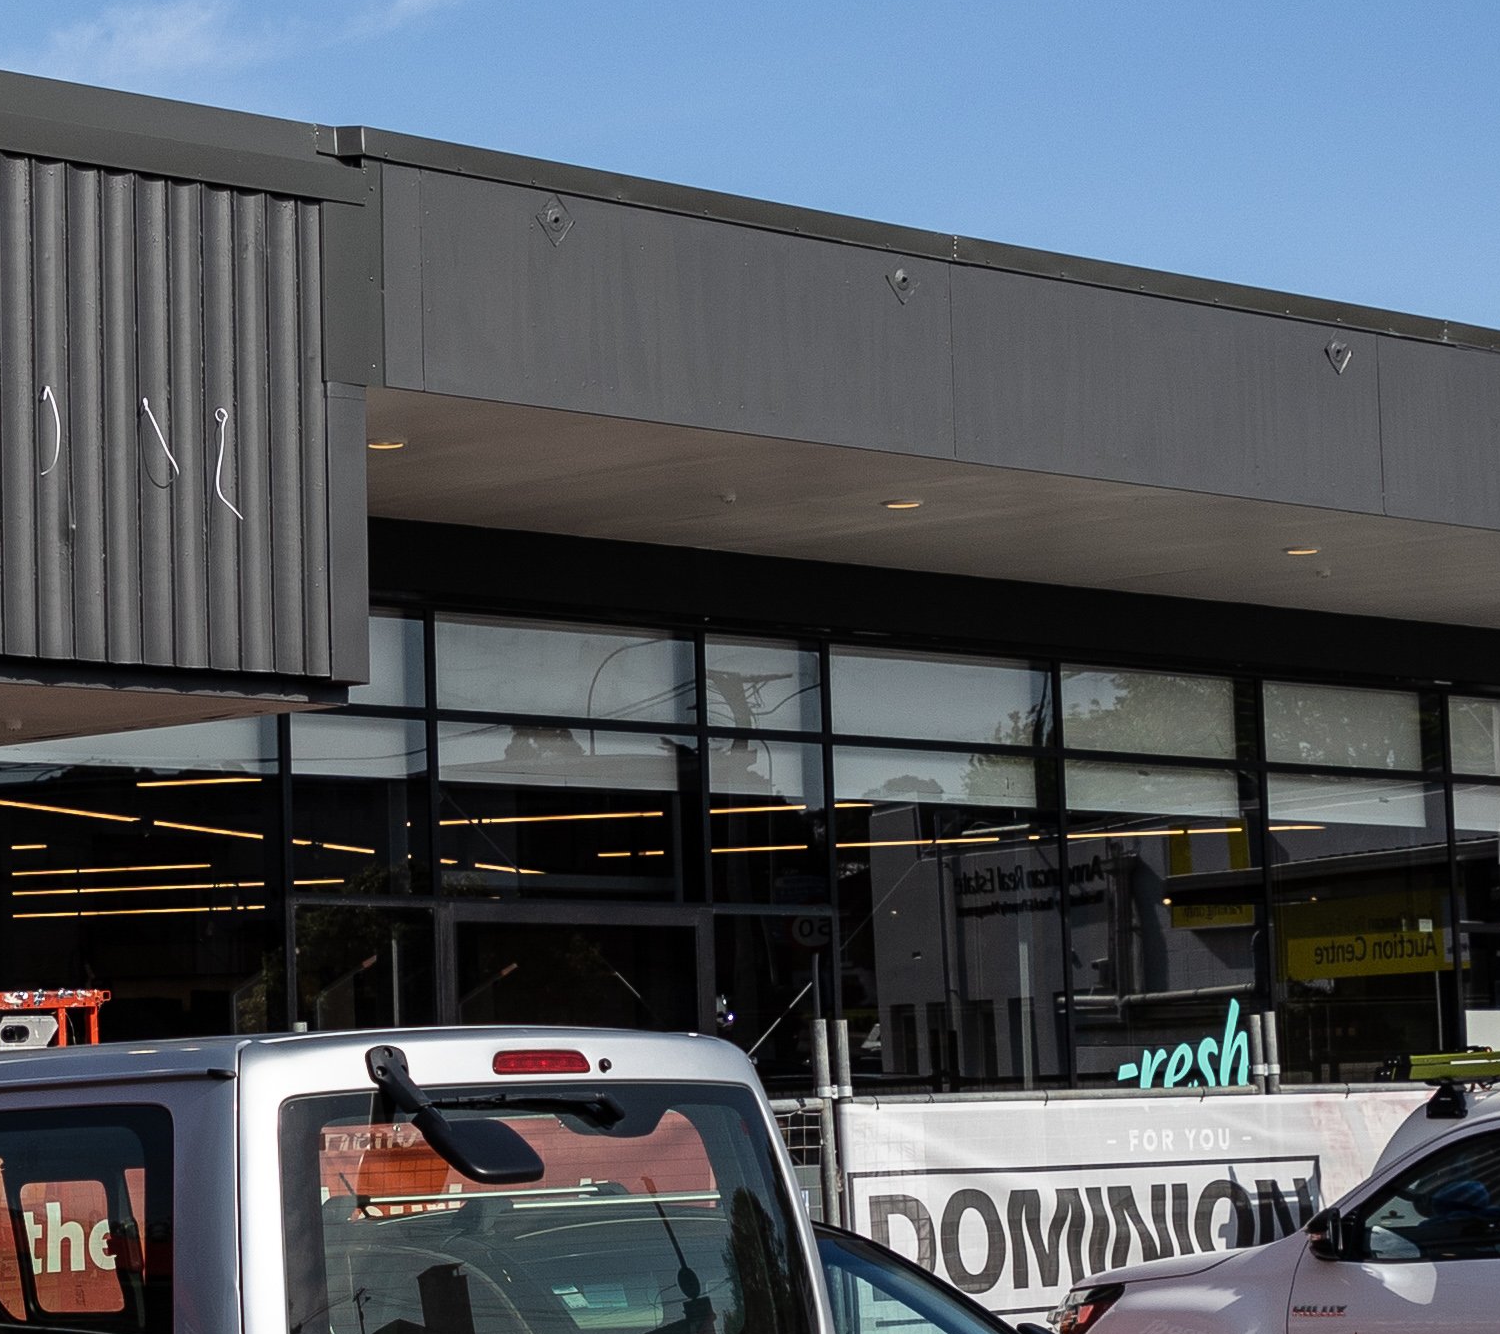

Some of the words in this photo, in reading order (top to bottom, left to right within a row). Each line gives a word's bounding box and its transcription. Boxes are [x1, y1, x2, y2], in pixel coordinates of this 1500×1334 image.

[1129, 1128, 1175, 1151] FOR
[1184, 1127, 1232, 1150] YOU
[868, 1177, 1318, 1303] DOMINION
